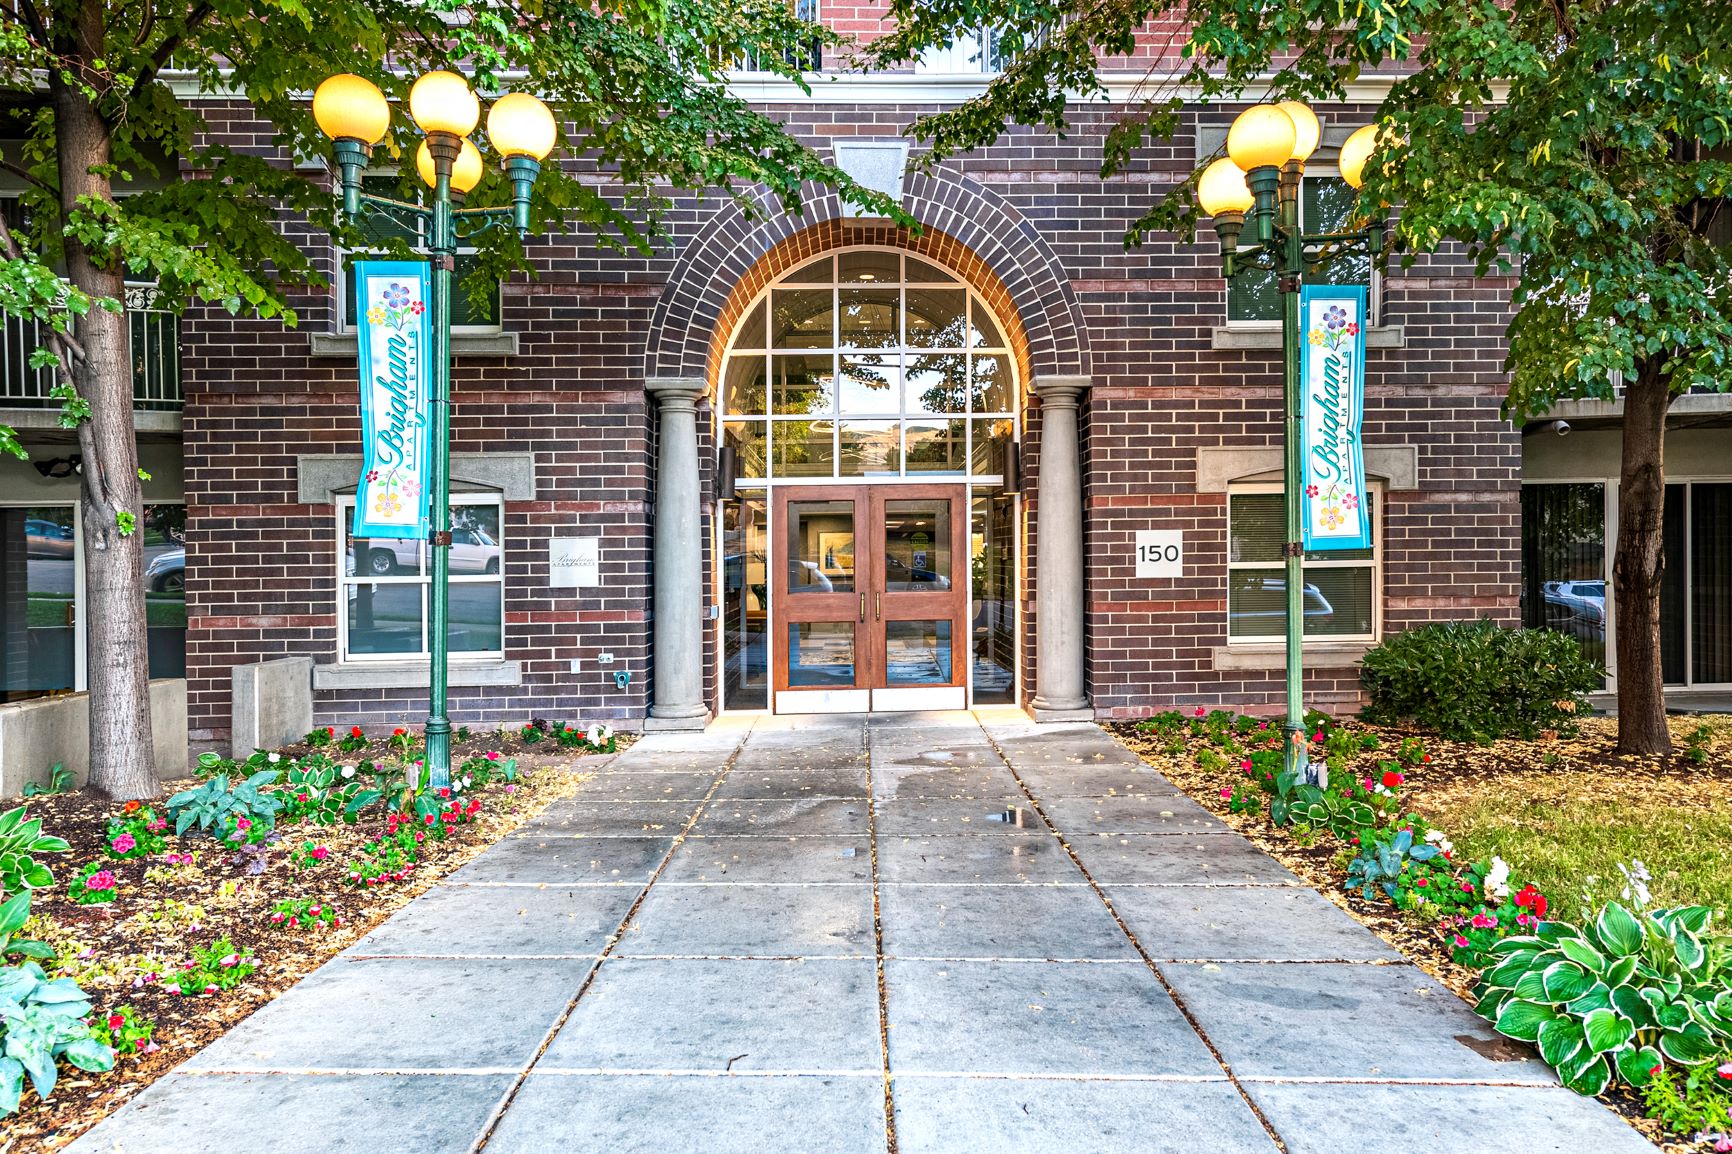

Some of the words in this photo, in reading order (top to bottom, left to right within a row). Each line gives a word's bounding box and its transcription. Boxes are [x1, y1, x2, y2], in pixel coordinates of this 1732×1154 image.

[376, 333, 426, 470] Brigham
[405, 330, 417, 471] APARTMENTS
[1311, 353, 1356, 484] Brigham
[1339, 351, 1351, 485] APARTMENTS
[1138, 545, 1179, 562] 150
